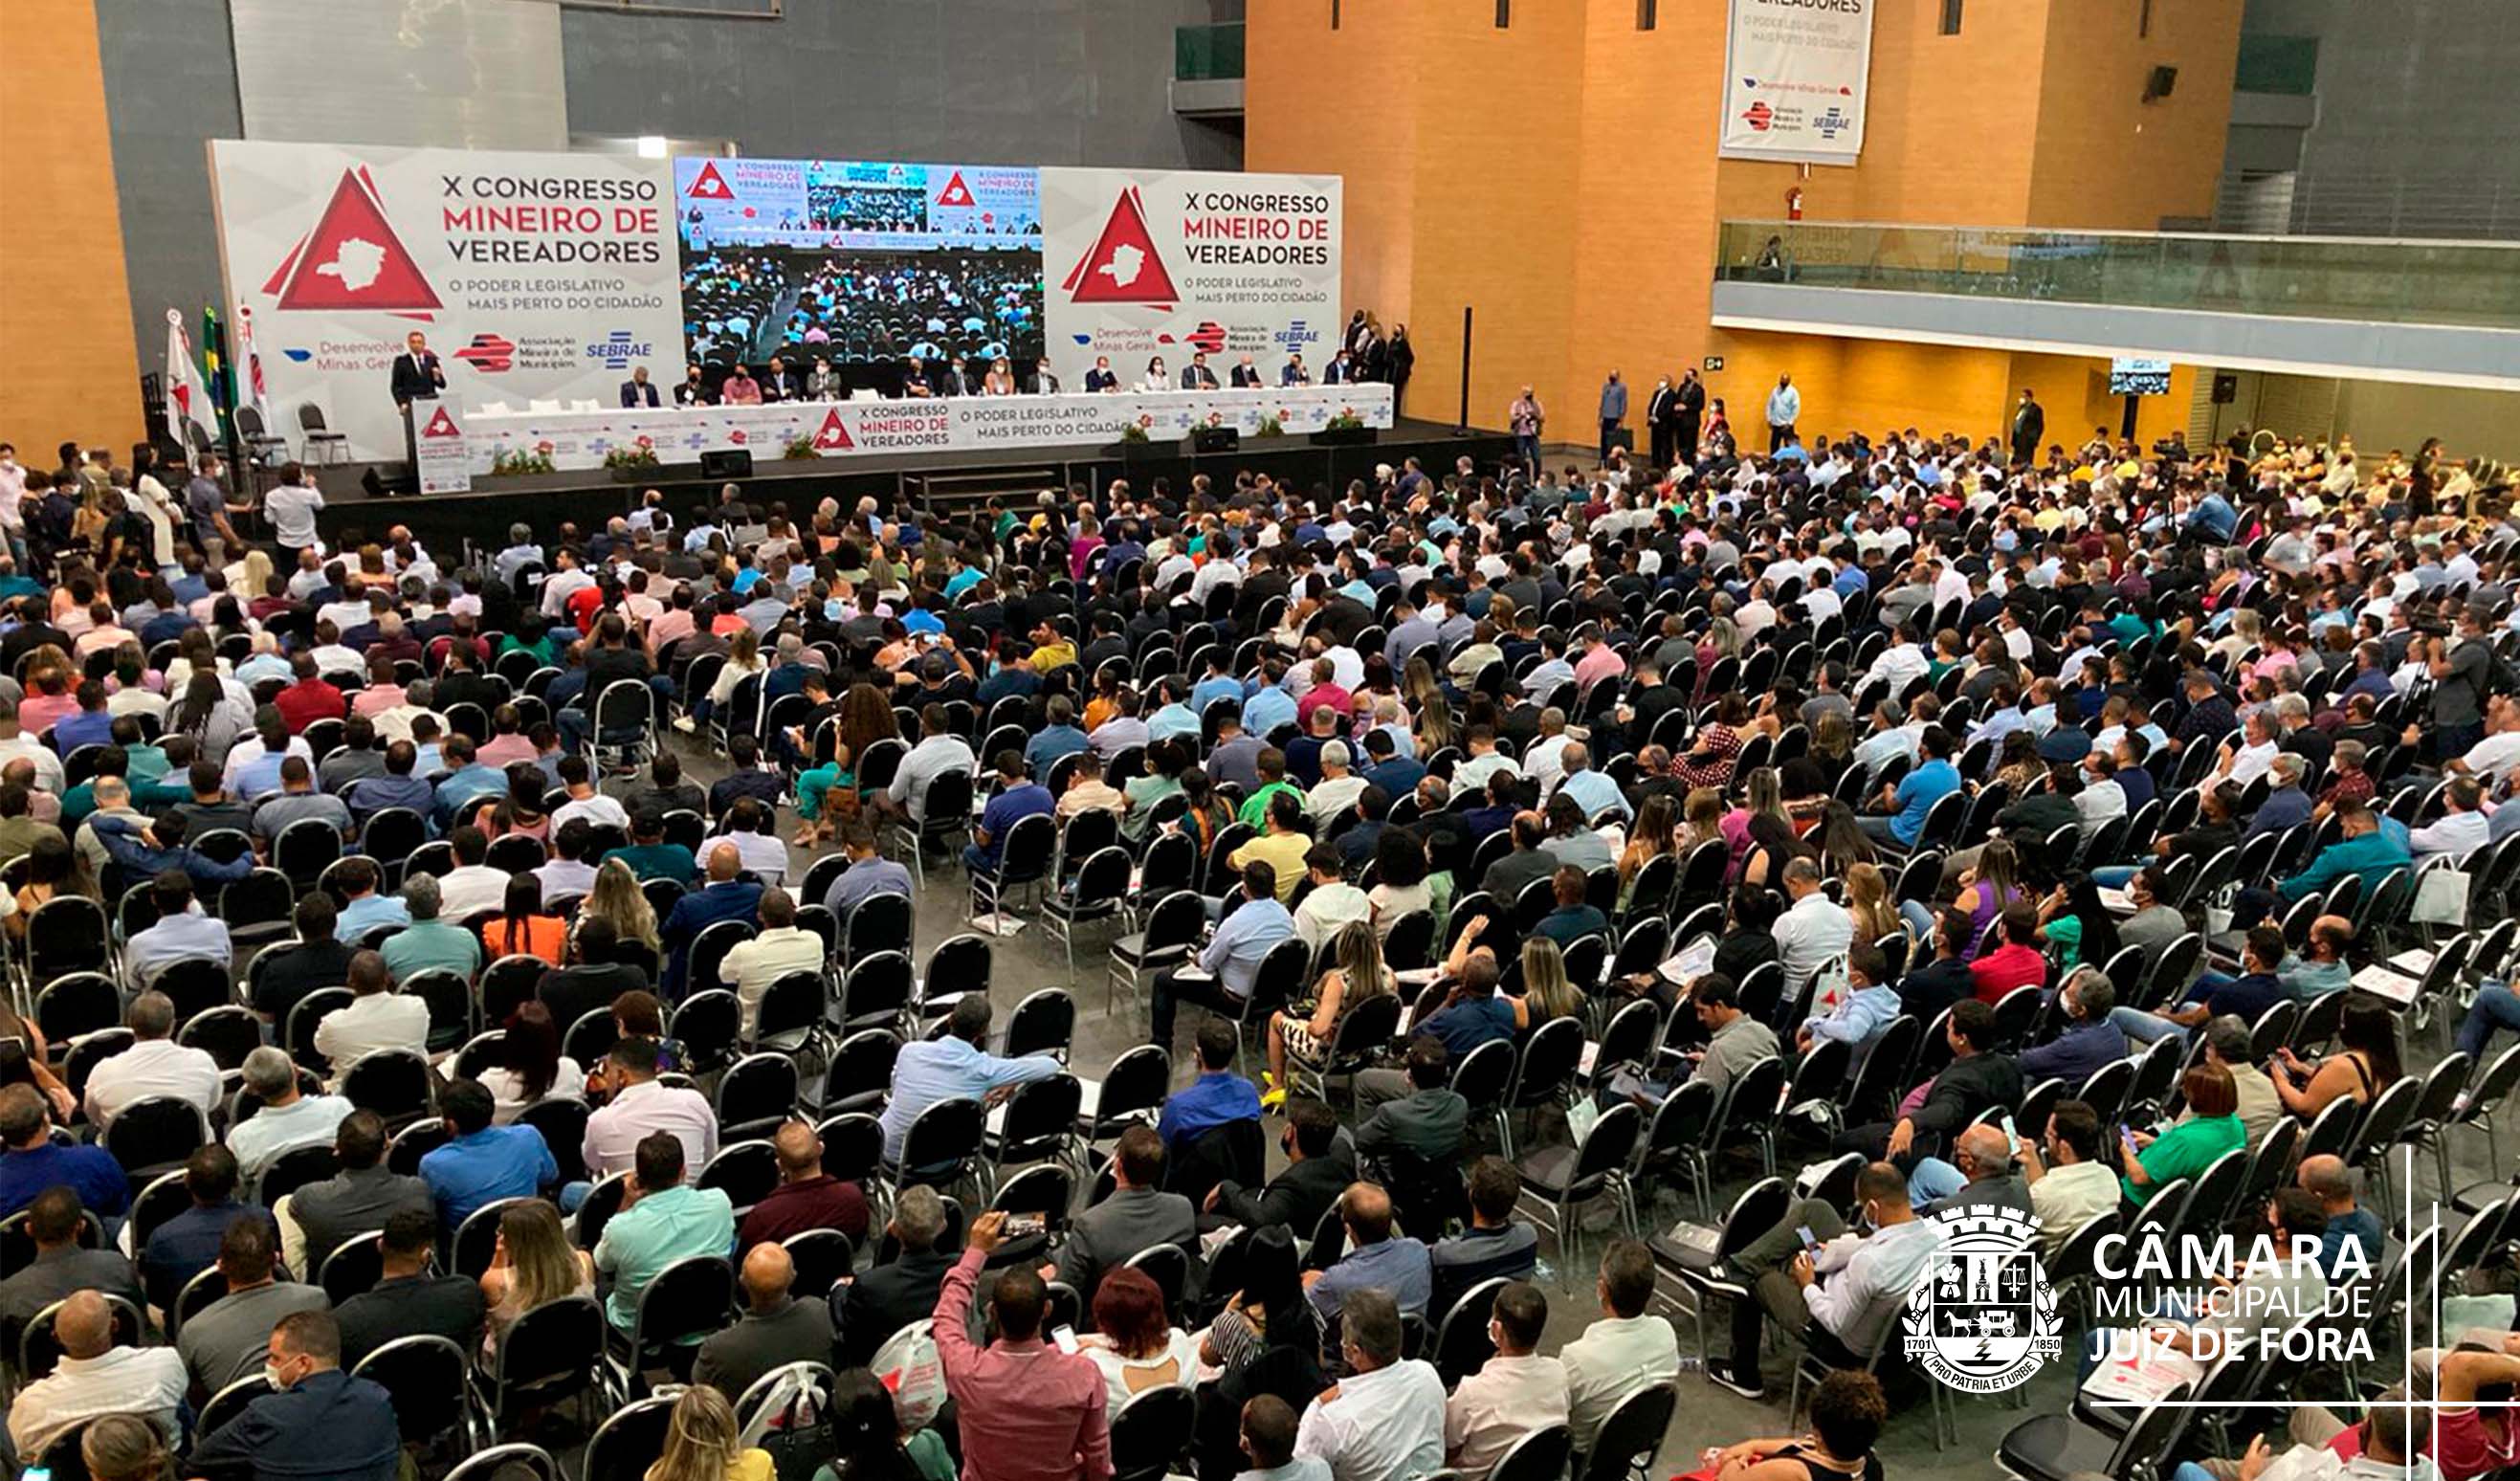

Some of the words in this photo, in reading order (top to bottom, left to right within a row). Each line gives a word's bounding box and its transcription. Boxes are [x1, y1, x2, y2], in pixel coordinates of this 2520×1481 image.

[1757, 0, 1862, 13] DORES
[1813, 117, 1850, 130] SEBRAE
[442, 176, 462, 197] X
[473, 177, 656, 201] CONGRESSO
[1185, 192, 1199, 210] X
[1205, 193, 1329, 213] CONGRESSO
[444, 207, 602, 233] MINEIRO
[614, 209, 659, 233] DE
[1183, 217, 1290, 240] MINEIRO
[1298, 219, 1328, 240] DE
[448, 240, 660, 263] VEREADORES
[1185, 245, 1328, 265] VEREADORES
[450, 279, 462, 292] O
[467, 279, 521, 293] PODER
[526, 278, 625, 292] LEGISLATIVO
[1184, 277, 1193, 288] O
[1196, 277, 1233, 288] PODER
[1235, 276, 1302, 289] LEGISLATIVO
[468, 298, 508, 310] MAIS
[513, 298, 564, 310] PERTO
[567, 298, 590, 309] DO
[594, 294, 663, 309] CIDADÃO
[1196, 293, 1223, 303] MAIS
[1226, 293, 1260, 303] PERTO
[1262, 292, 1278, 303] DO
[1281, 290, 1328, 303] CIDADÃO
[1096, 327, 1153, 339] Desenvolve
[1273, 331, 1319, 343] SEBRAE
[320, 340, 405, 354] Desenvolve
[586, 344, 652, 358] SEBRAE
[1094, 342, 1122, 352] Minas
[1125, 340, 1156, 352] Gerais
[317, 357, 361, 370] Minas
[365, 356, 391, 370] Ger
[860, 409, 869, 418] X
[872, 405, 948, 418] CONGRESSO
[961, 411, 971, 423] O
[974, 409, 1018, 422] PODER
[1020, 407, 1098, 421] LEGISLATIVO
[859, 418, 925, 433] MINEIRO
[929, 417, 949, 431] DE
[977, 425, 1009, 439] MAIS
[1011, 424, 1051, 438] PERTO
[1055, 423, 1073, 435] DO
[861, 432, 950, 448] VEREADORES
